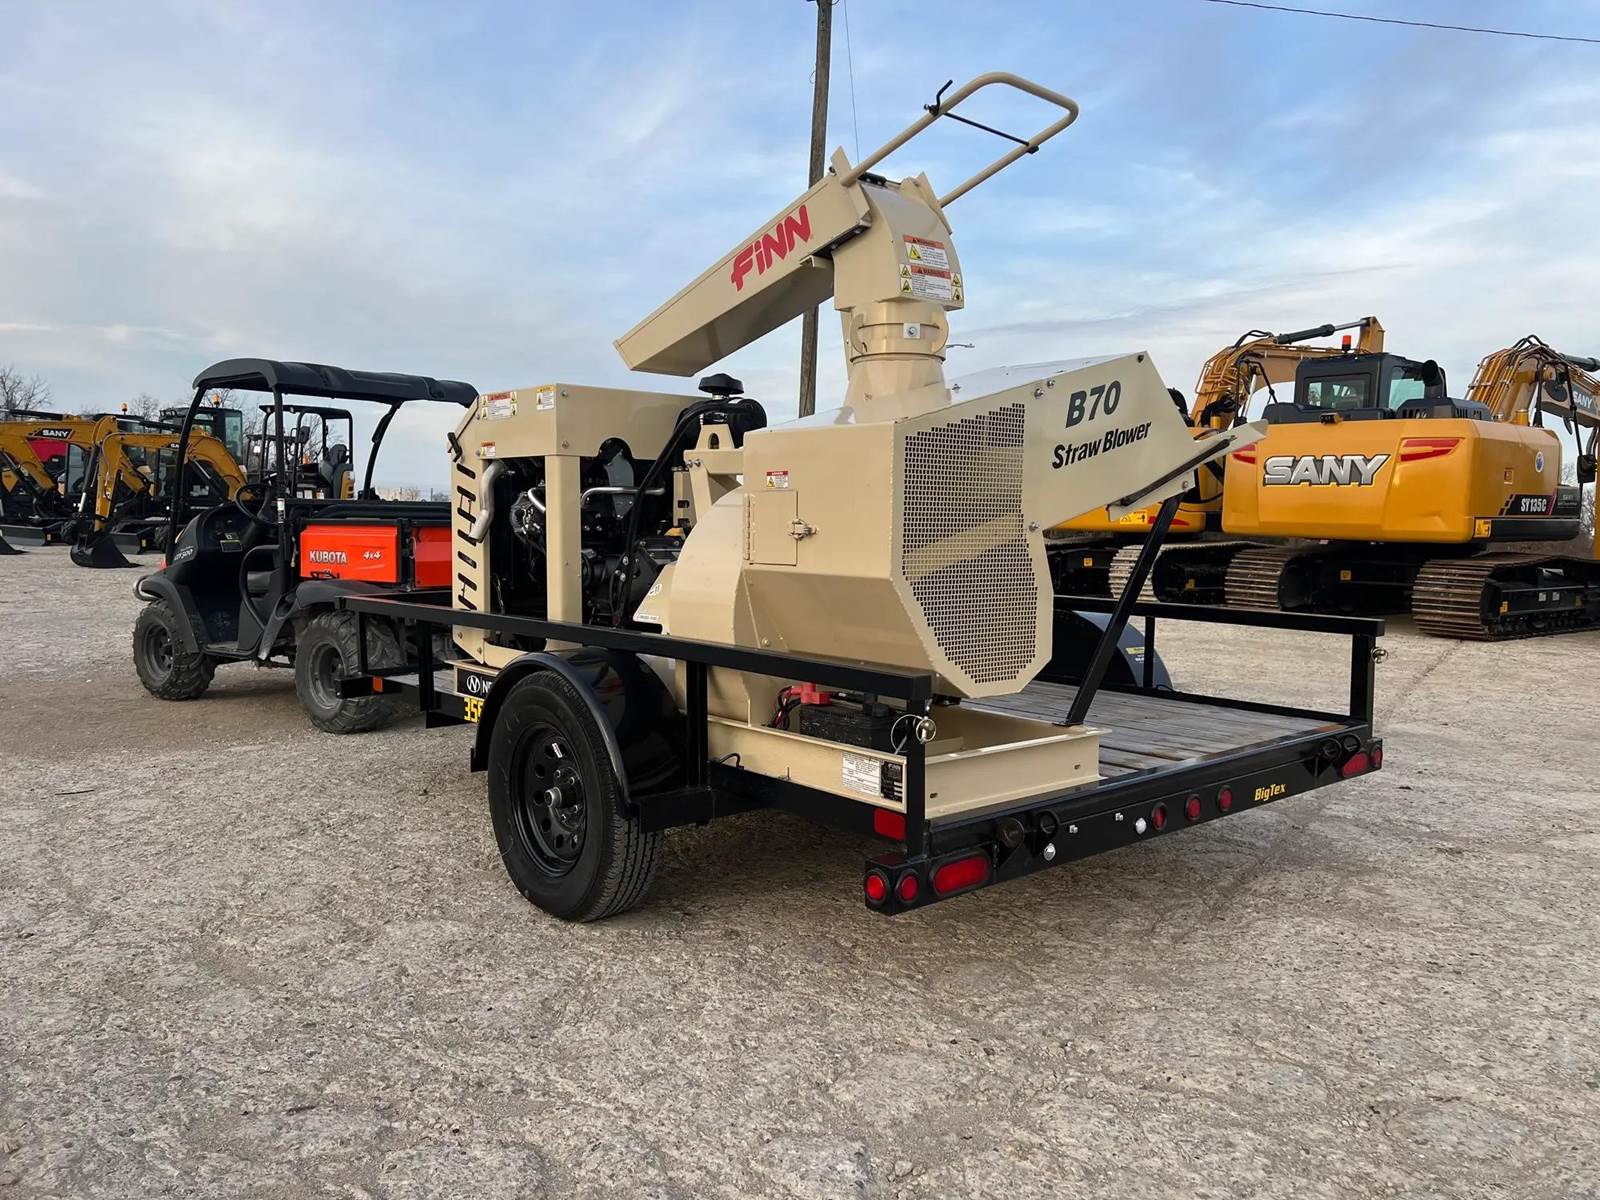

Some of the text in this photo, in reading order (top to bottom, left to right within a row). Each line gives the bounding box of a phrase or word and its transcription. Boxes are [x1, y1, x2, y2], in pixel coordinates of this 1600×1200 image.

[1065, 380, 1122, 428] B70
[1572, 390, 1593, 409] SANY
[42, 429, 69, 438] SANY
[1052, 421, 1152, 469] Straw Blower
[1263, 454, 1391, 487] SANY
[309, 550, 382, 564] KUBOTA 4x4
